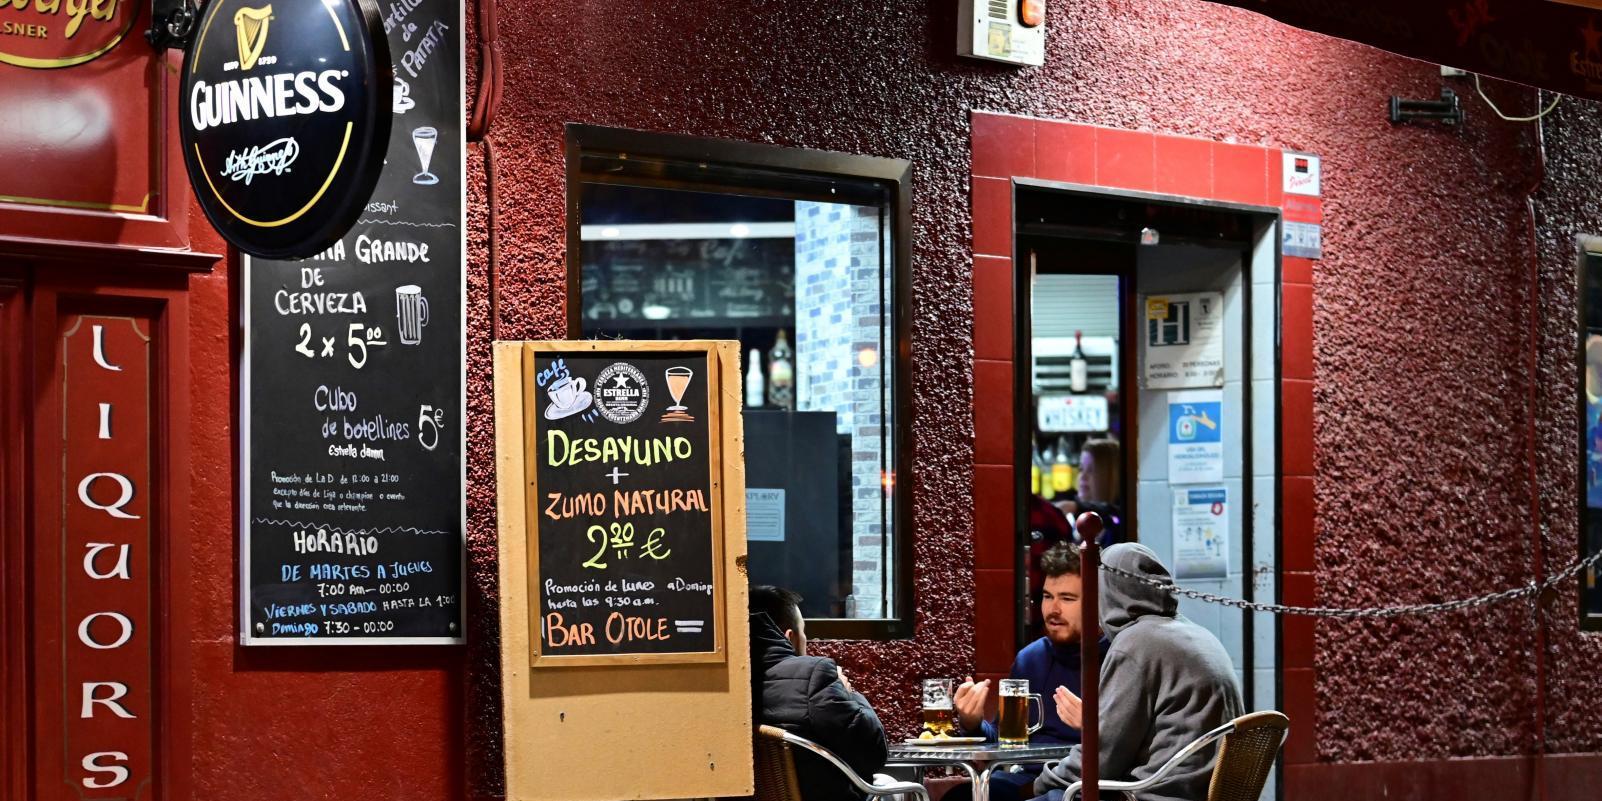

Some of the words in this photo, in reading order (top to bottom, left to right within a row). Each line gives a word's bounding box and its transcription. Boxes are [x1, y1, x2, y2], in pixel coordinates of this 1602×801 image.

[0, 21, 48, 38] SNER
[401, 20, 449, 78] PATATA
[191, 70, 345, 131] GUINNESS
[364, 199, 399, 215] issant
[355, 234, 430, 264] GRANDE
[301, 267, 324, 289] DE
[274, 289, 367, 315] CERVEZA
[295, 322, 315, 358] 2
[314, 384, 357, 412] Cubo
[603, 388, 640, 397] ESTRELLA
[321, 417, 338, 439] de
[343, 414, 410, 441] botellines
[547, 429, 692, 467] DESAYUNO
[545, 493, 606, 520] ZUMO
[614, 489, 708, 518] NATURAL
[77, 324, 141, 789] LIQUORS
[281, 564, 301, 582] DE
[309, 564, 371, 581] MARTES
[377, 565, 387, 579] A
[391, 560, 433, 579] JUEVES
[317, 583, 345, 597] 7:00
[379, 582, 410, 595] 00:00
[545, 578, 600, 596] Promoción
[604, 580, 617, 592] de
[383, 597, 415, 611] HASTA
[419, 596, 431, 607] LA
[582, 597, 599, 607] las
[605, 597, 631, 607] 9:30
[271, 622, 319, 637] Domingo
[323, 621, 350, 635] 7:30
[363, 620, 394, 634] 00:00
[546, 612, 595, 647] BAR
[605, 612, 671, 644] OTOLE
